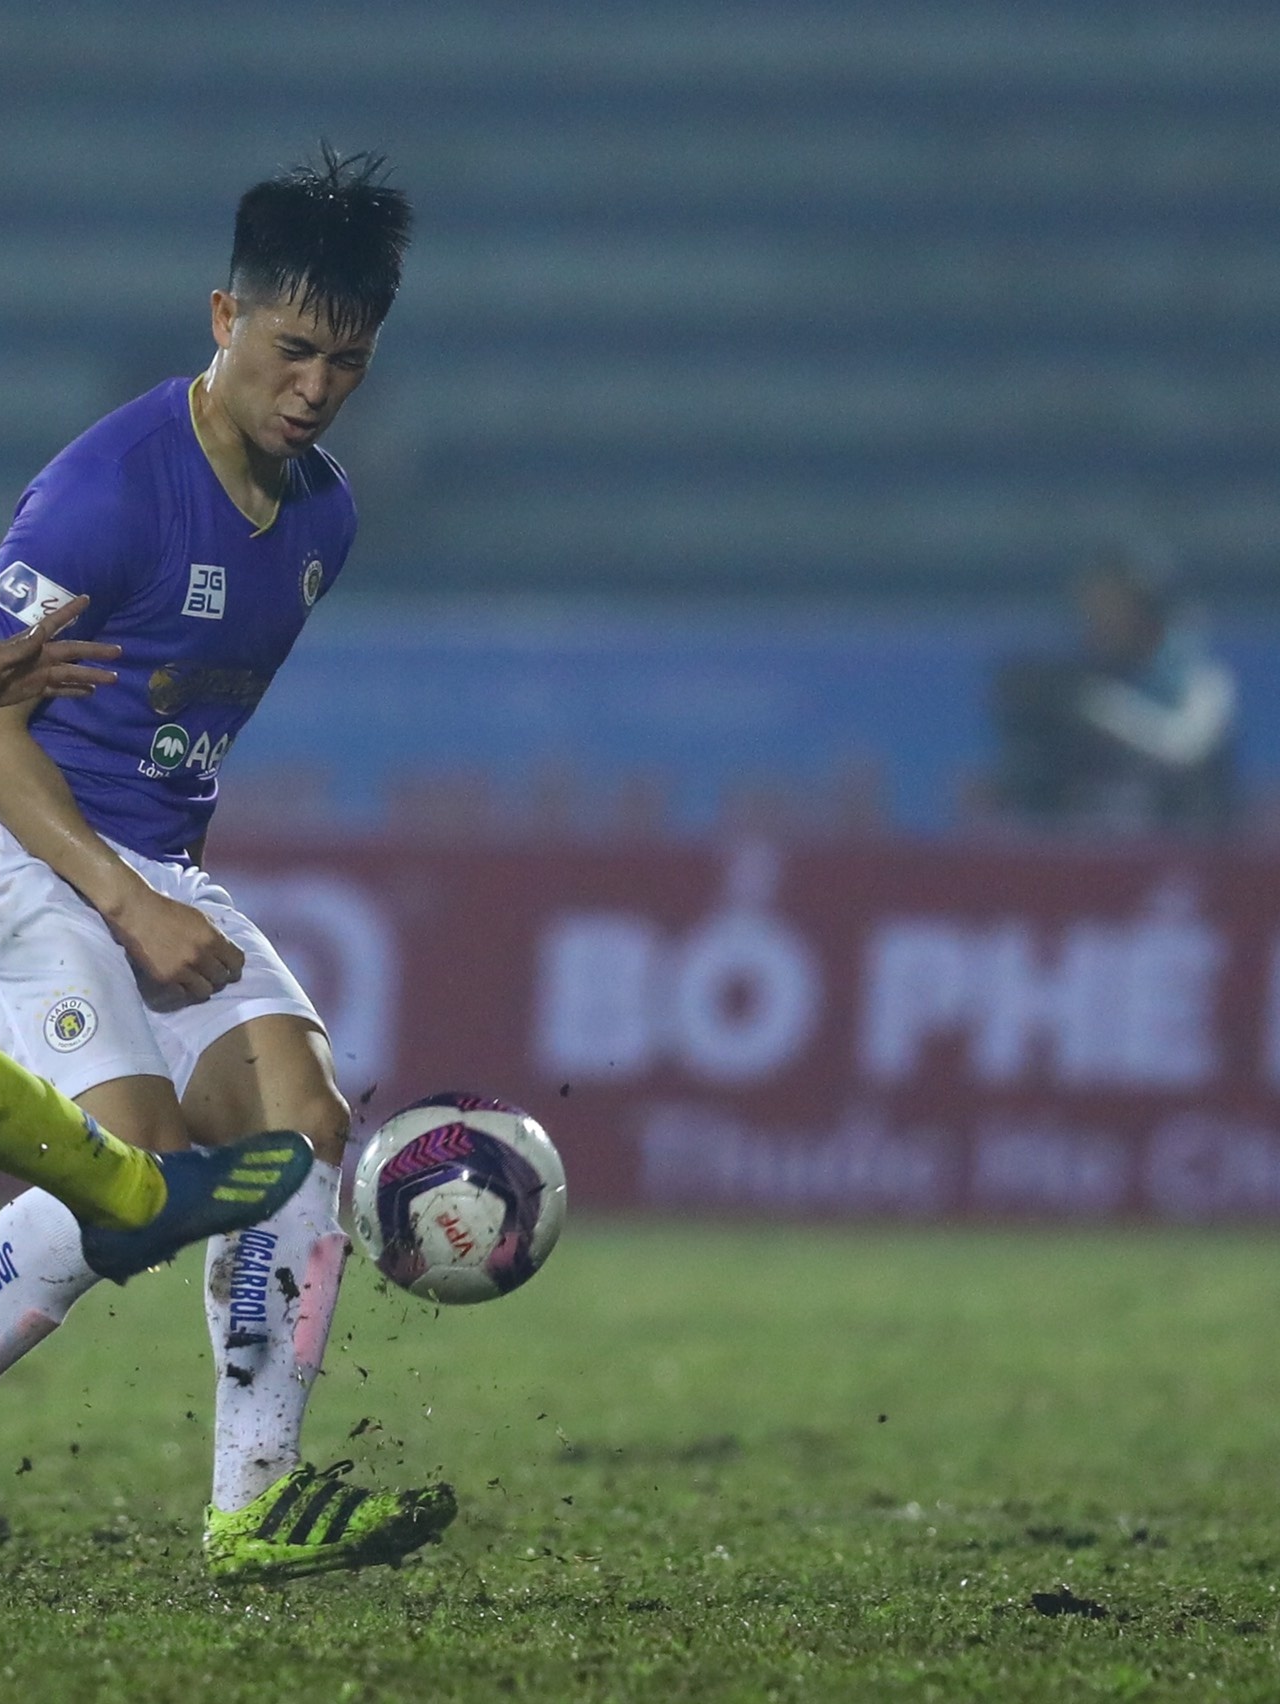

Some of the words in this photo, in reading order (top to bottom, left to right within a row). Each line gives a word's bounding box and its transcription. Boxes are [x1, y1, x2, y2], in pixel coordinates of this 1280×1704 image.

[193, 570, 222, 591] JG
[187, 592, 220, 614] BL
[48, 1000, 82, 1023] HANOI
[435, 1212, 474, 1259] VPF
